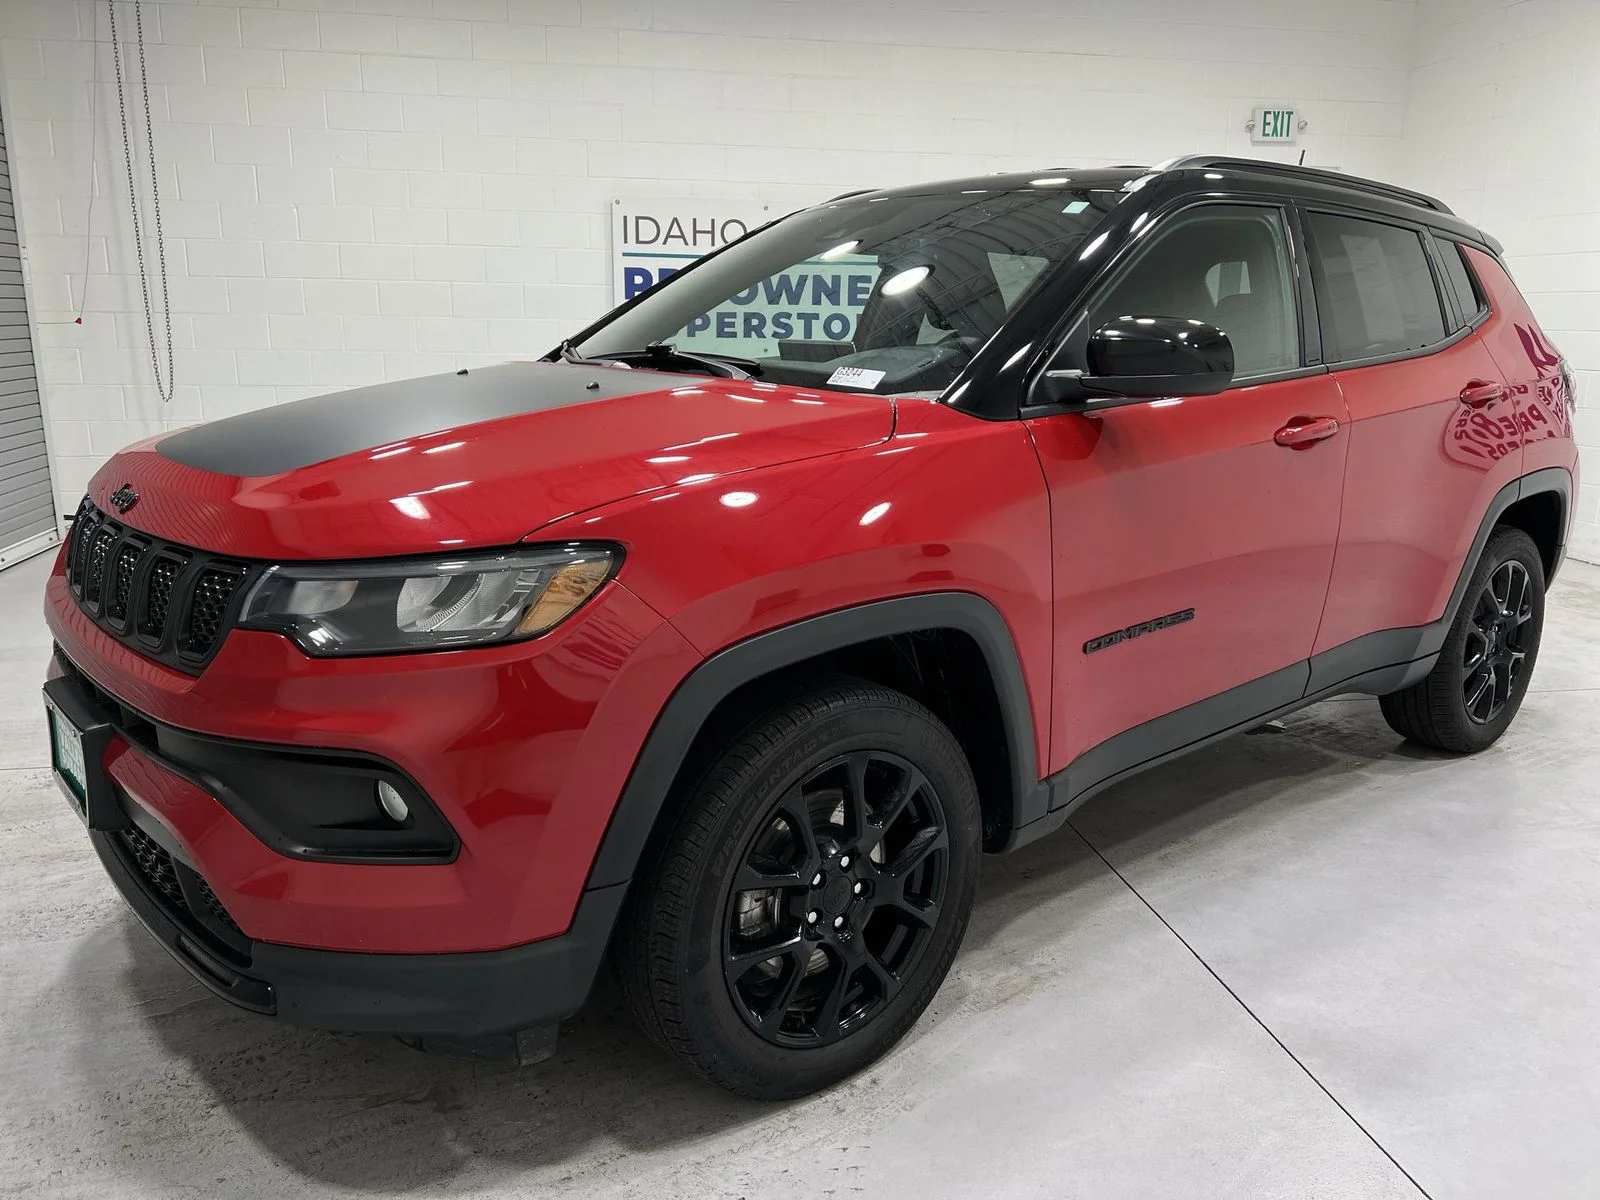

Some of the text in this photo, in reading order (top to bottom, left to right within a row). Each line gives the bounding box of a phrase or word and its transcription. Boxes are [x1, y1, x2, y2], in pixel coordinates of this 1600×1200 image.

[1262, 110, 1294, 138] EXIT
[622, 215, 748, 246] IDAHO
[686, 311, 863, 340] PERSTO
[1082, 607, 1195, 654] COMPASS
